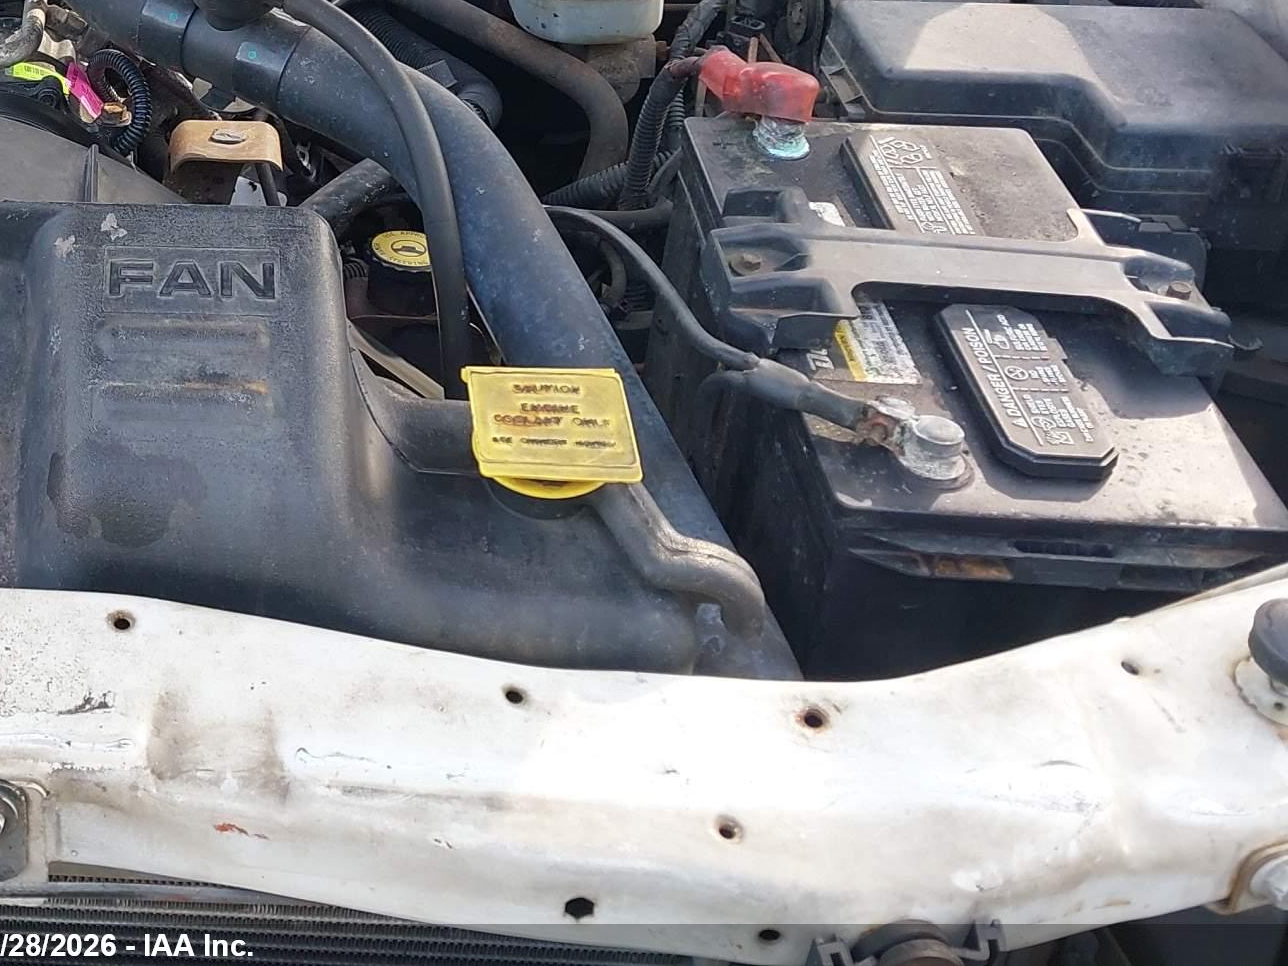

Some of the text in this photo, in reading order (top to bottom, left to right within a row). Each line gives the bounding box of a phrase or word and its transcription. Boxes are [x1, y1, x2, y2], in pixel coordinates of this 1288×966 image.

[109, 258, 276, 301] FAN
[961, 327, 993, 365] POISON
[519, 402, 581, 415] ENGINE
[986, 373, 1023, 418] DANGER
